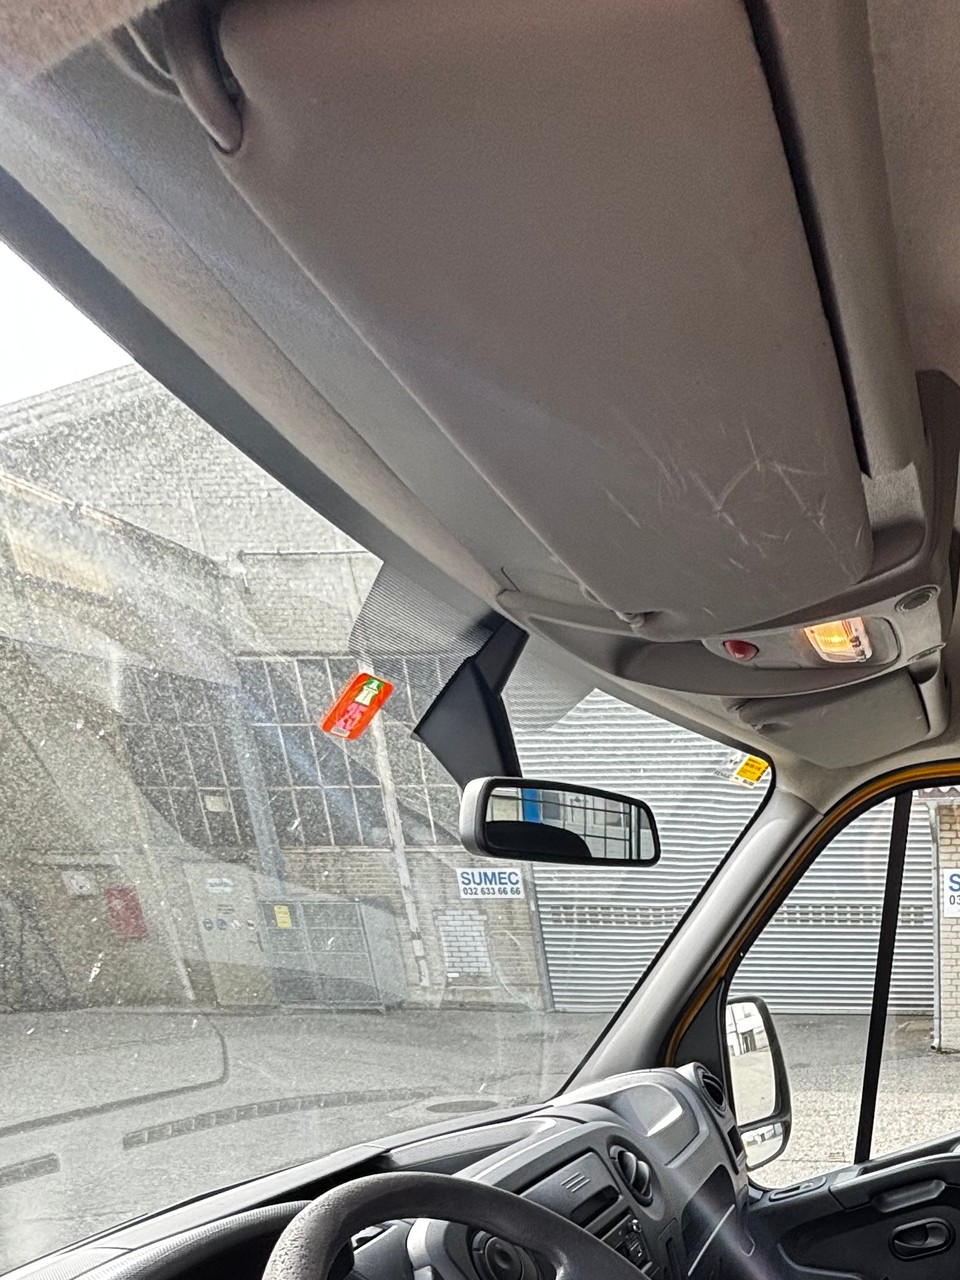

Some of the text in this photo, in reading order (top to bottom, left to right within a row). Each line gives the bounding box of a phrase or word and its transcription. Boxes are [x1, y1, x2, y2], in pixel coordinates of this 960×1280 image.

[460, 871, 520, 886] SUMEC
[463, 887, 521, 896] 032 633 66 66
